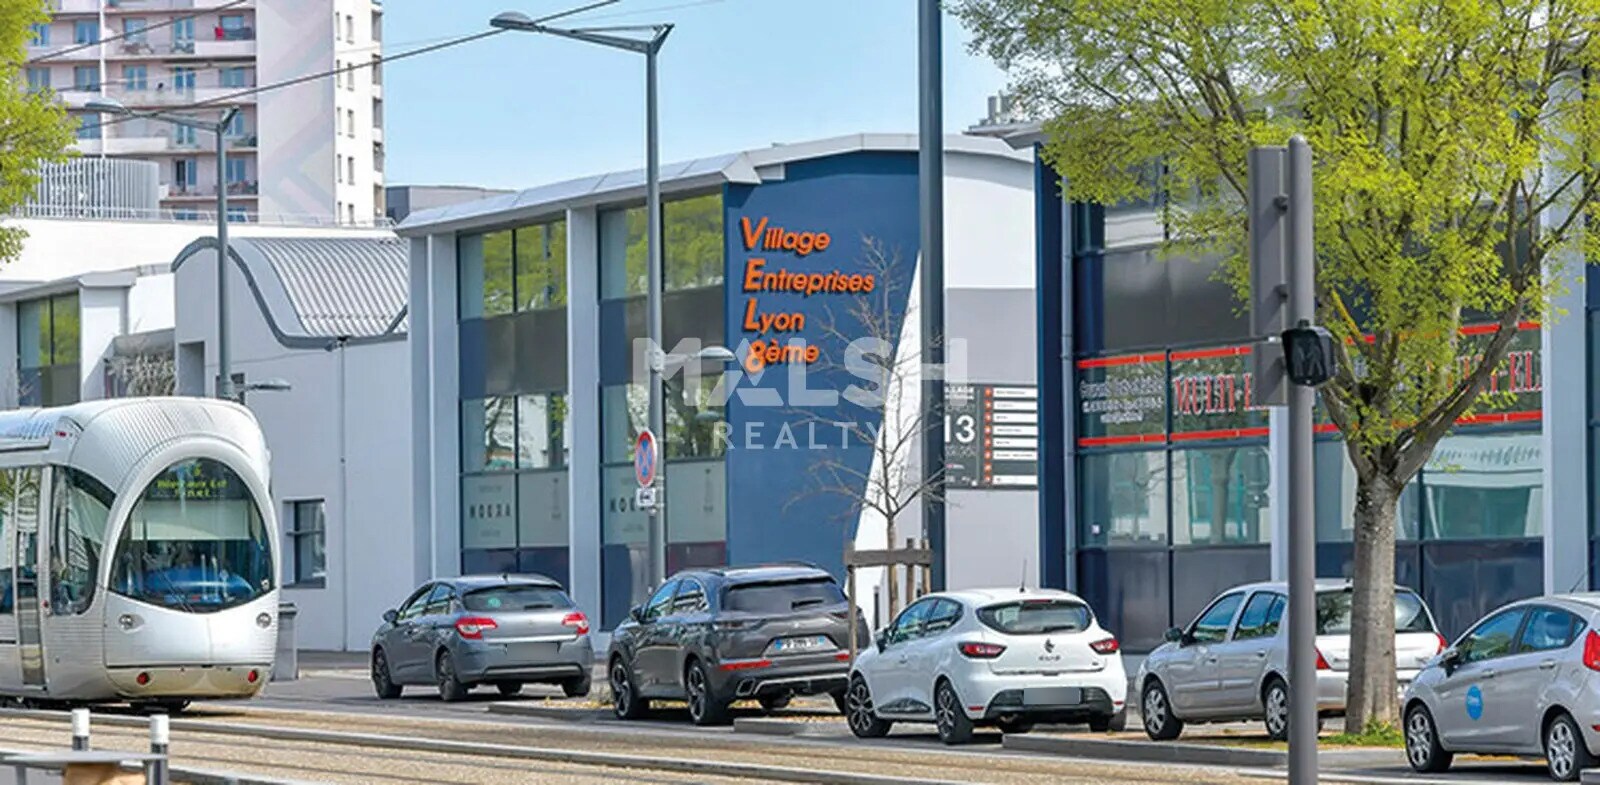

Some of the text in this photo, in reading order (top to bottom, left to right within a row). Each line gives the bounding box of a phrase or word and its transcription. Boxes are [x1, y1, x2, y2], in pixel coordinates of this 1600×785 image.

[741, 216, 832, 256] Village
[744, 257, 876, 295] Entreprises
[744, 297, 805, 335] Lyon
[745, 337, 820, 373] 8ème
